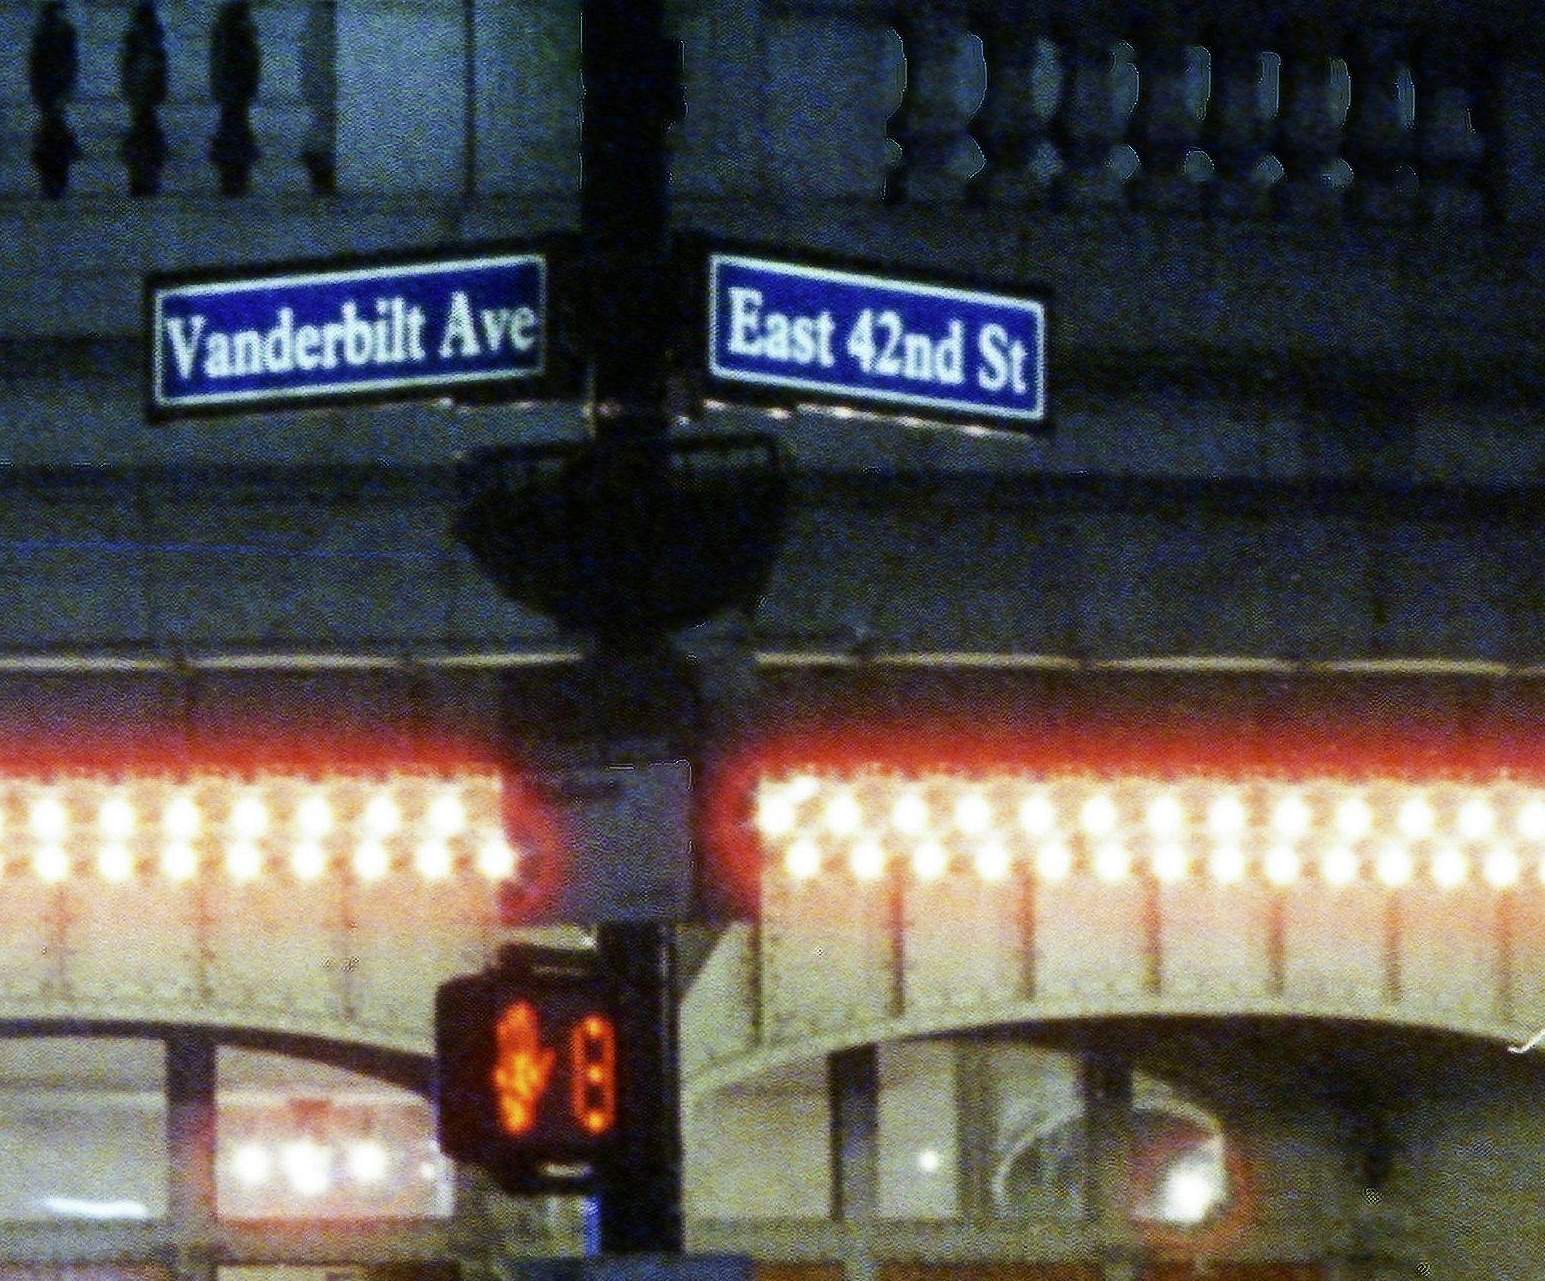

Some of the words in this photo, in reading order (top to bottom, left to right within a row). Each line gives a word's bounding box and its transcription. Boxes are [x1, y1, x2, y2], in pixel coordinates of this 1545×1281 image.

[167, 295, 427, 380] Vanderbilt
[439, 290, 537, 358] Ave
[727, 287, 836, 369] East
[847, 307, 965, 385] 42nd
[977, 322, 1029, 396] St
